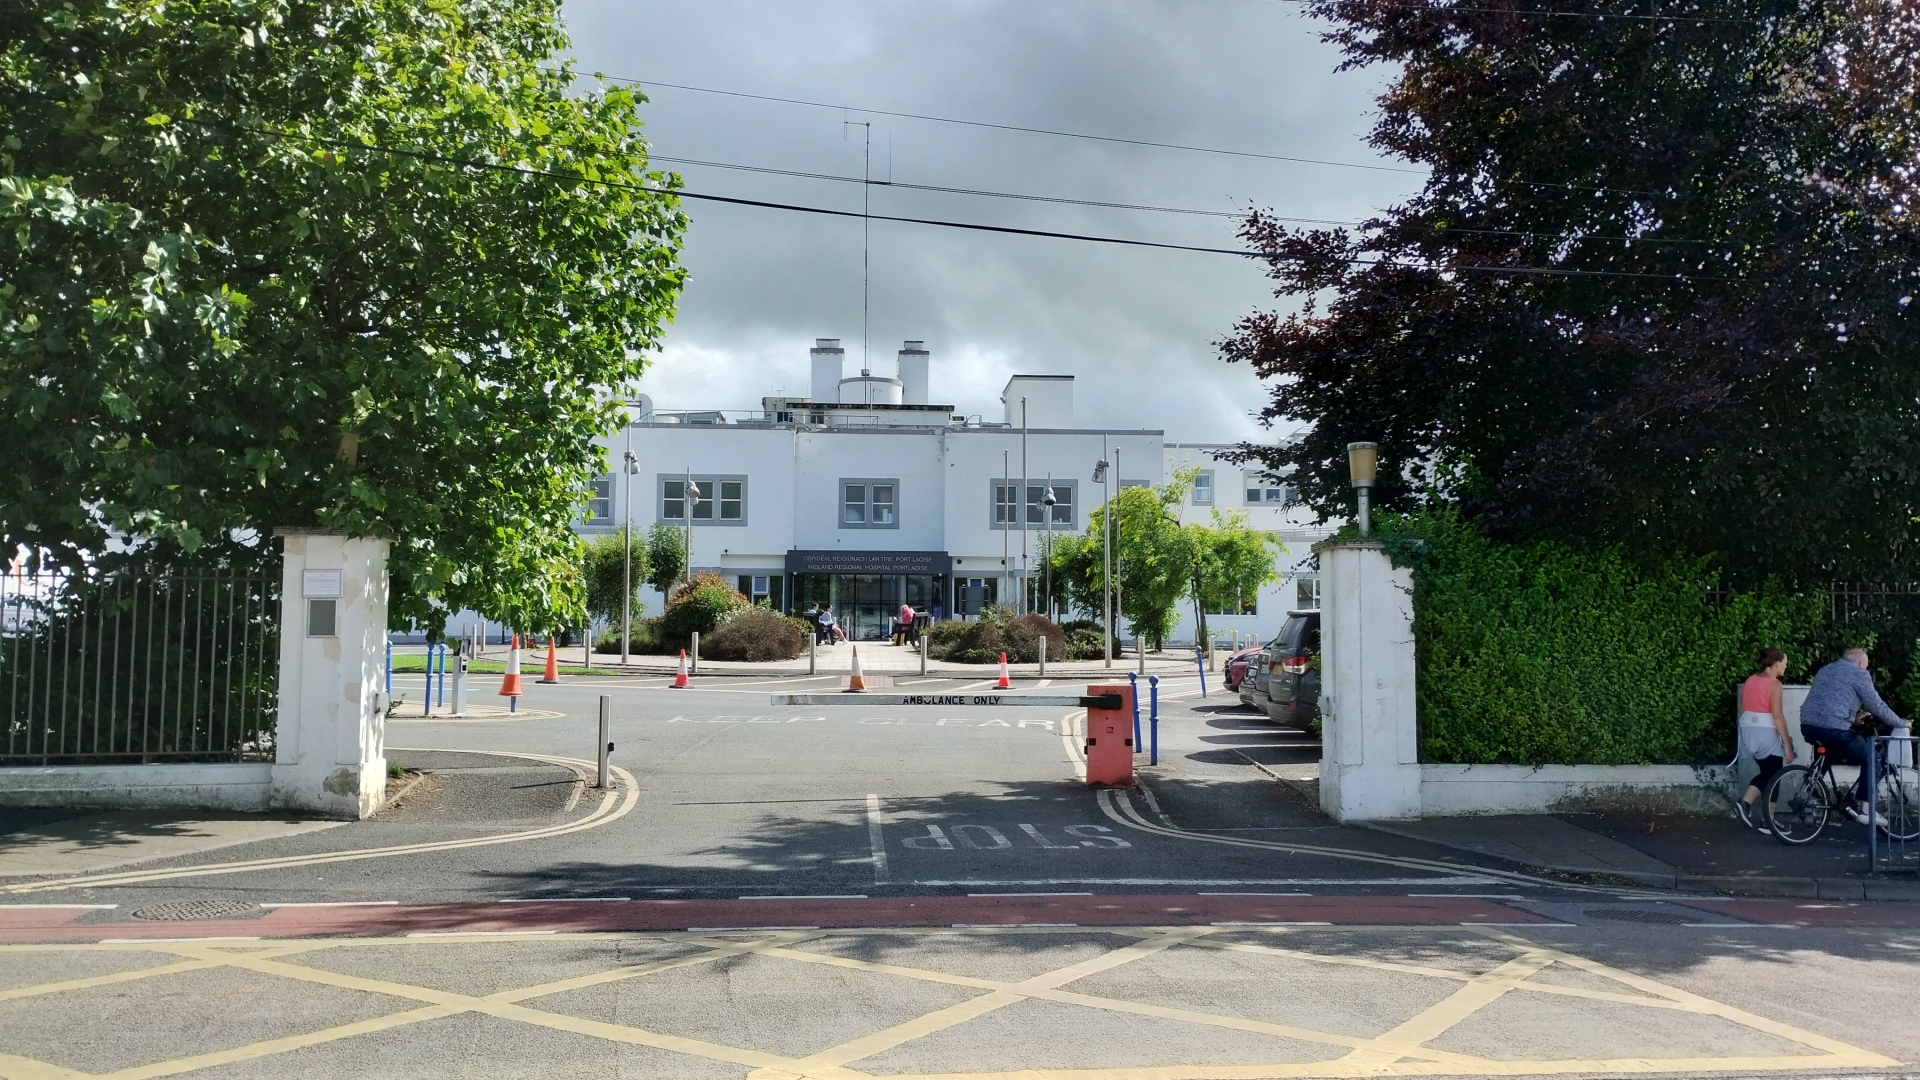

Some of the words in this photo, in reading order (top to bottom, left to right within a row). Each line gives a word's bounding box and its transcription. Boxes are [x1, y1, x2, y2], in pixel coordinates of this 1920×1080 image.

[902, 695, 966, 706] AMBULANCE
[973, 695, 1001, 706] ONLY
[667, 714, 827, 724] KEEP
[856, 717, 1055, 731] CLEAR
[901, 823, 1133, 850] STOP
